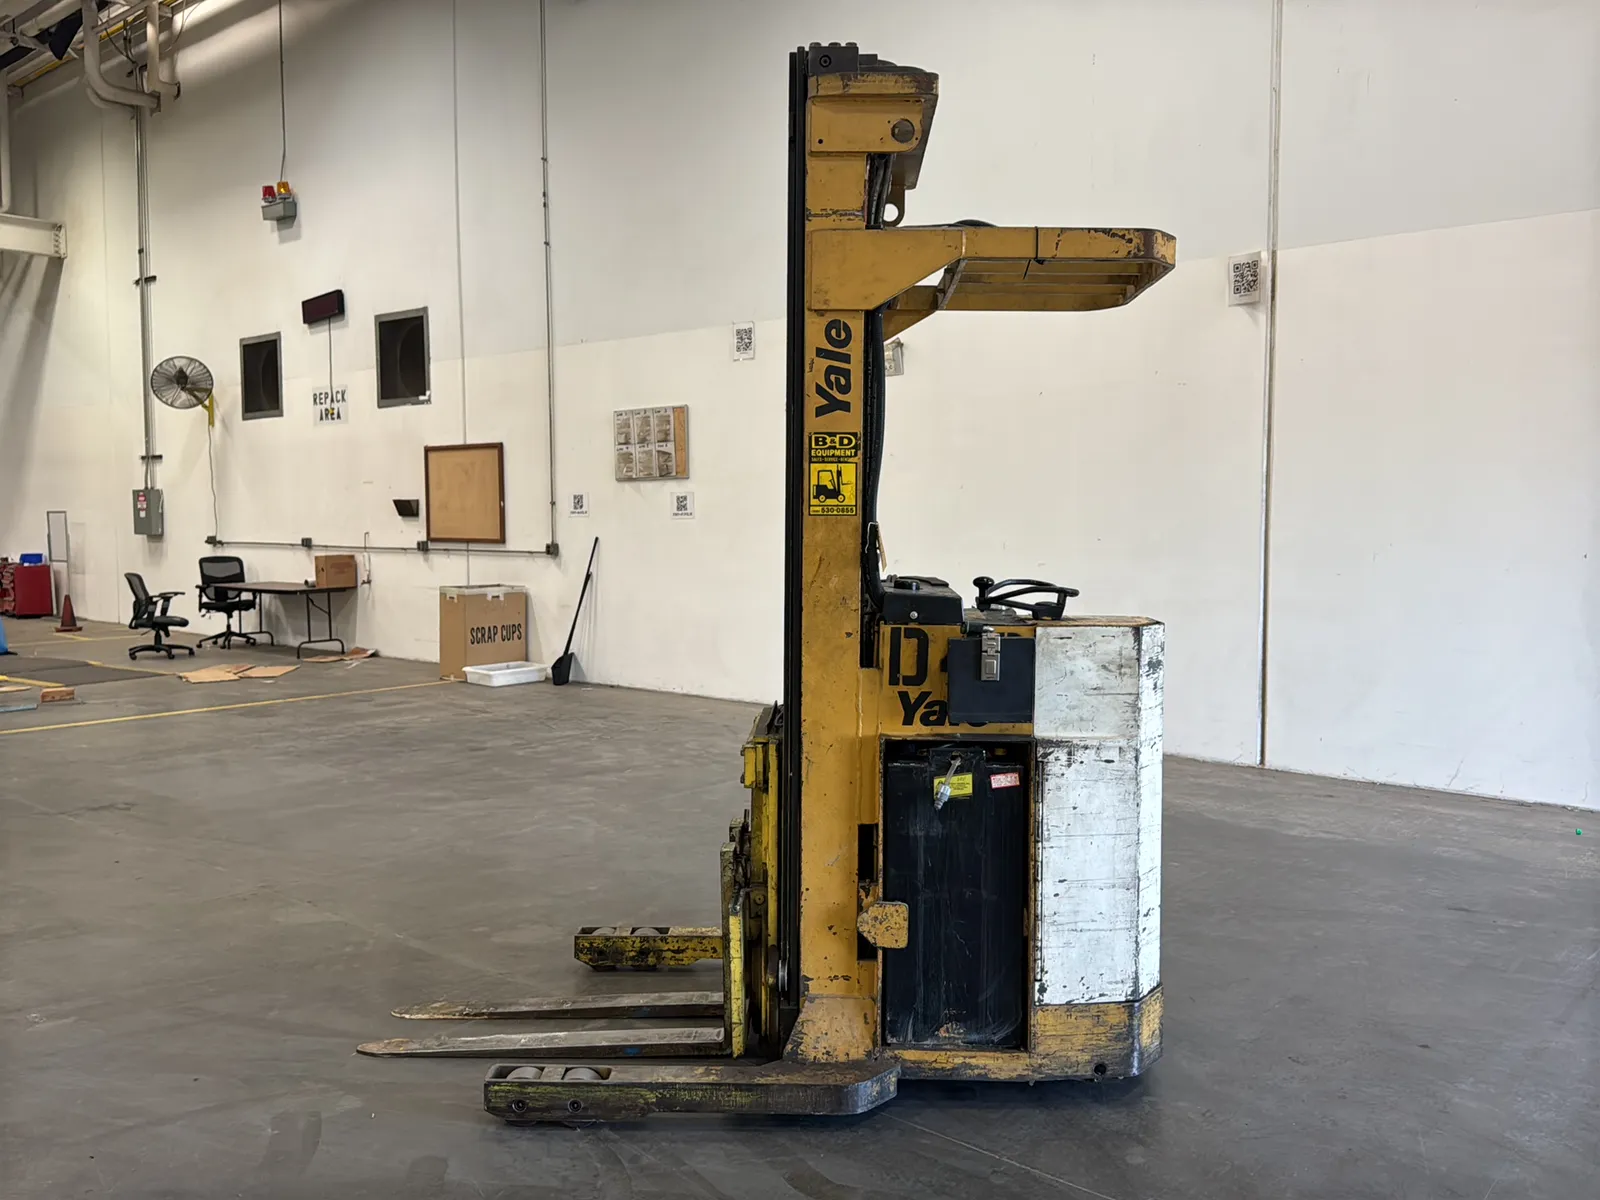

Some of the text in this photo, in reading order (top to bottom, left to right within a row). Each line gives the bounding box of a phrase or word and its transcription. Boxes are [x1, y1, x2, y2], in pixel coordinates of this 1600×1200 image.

[815, 319, 852, 418] Yale
[313, 389, 346, 406] REPACK
[319, 407, 341, 421] AREA
[811, 434, 856, 449] B&D
[811, 449, 856, 457] EQUIPMENT
[470, 623, 522, 645] SCRAP CUPS
[897, 691, 989, 727] Ya
